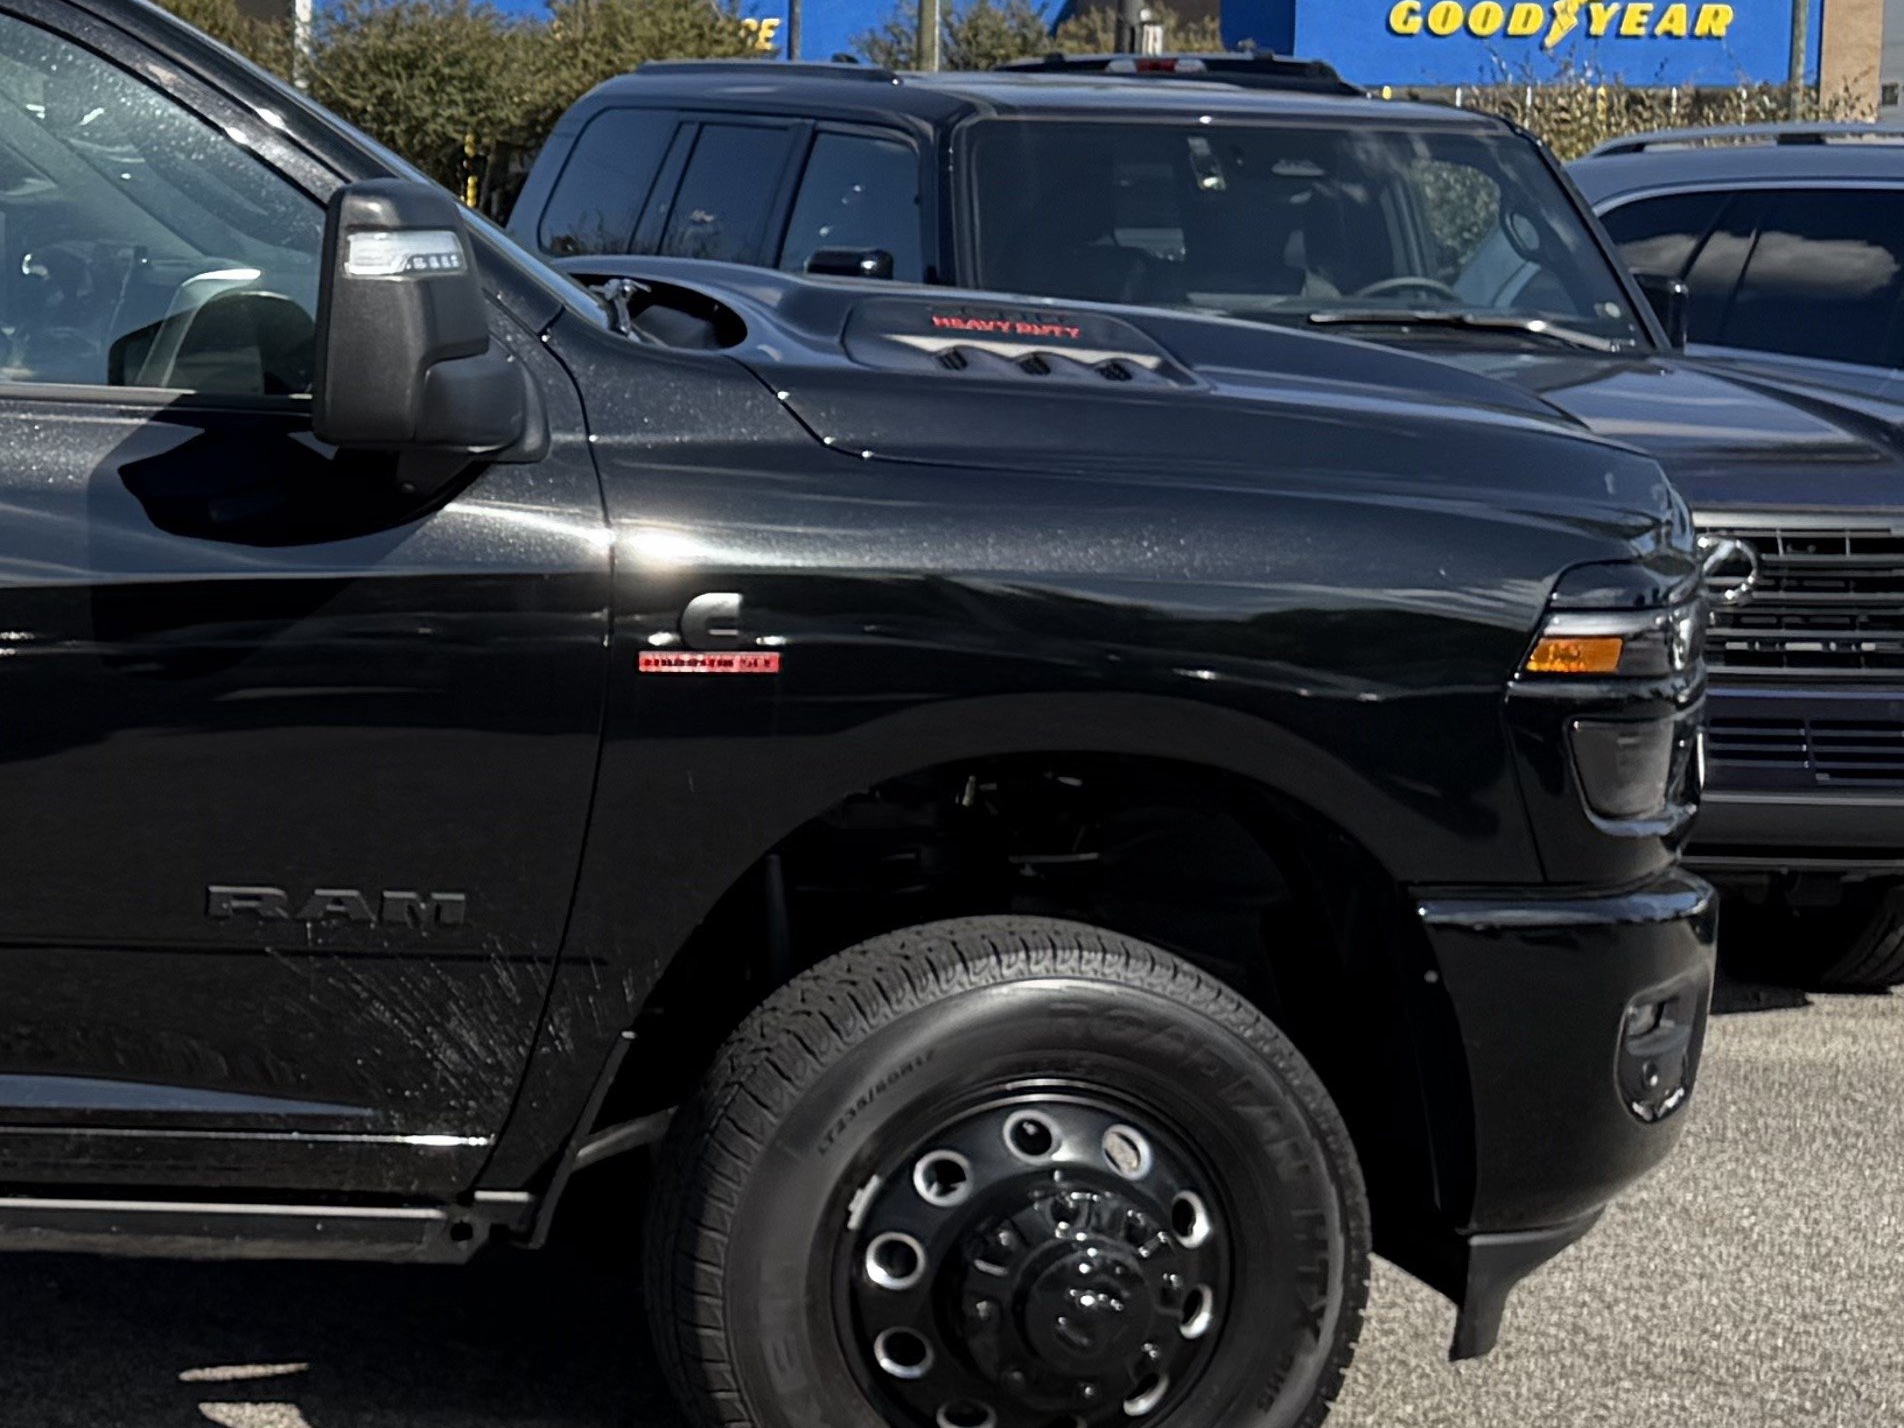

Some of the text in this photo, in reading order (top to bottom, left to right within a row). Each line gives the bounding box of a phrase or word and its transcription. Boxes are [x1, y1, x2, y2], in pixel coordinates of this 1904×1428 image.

[932, 315, 1081, 339] HEAVY DUTY
[207, 884, 467, 926] RAM
